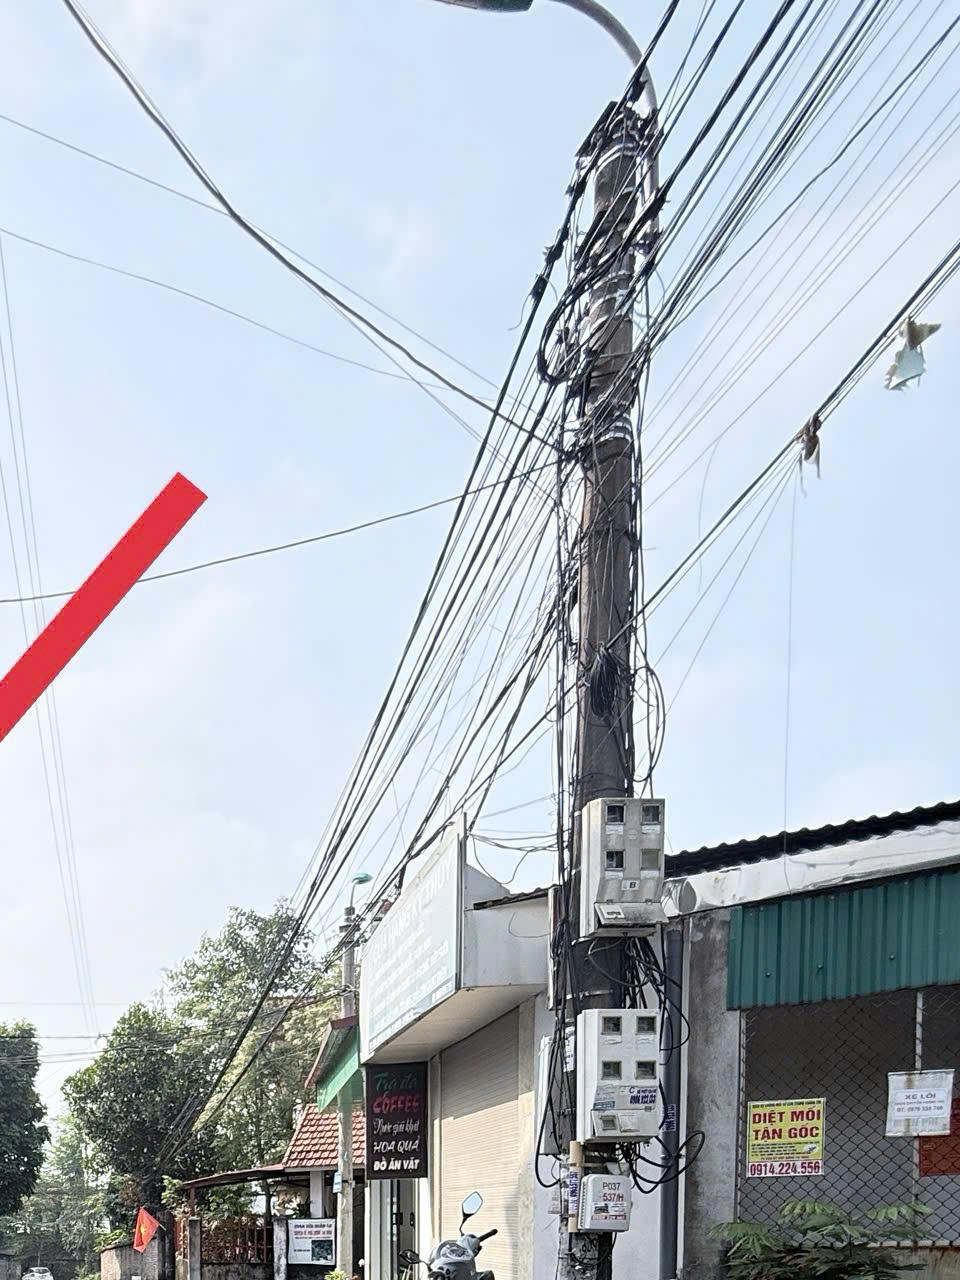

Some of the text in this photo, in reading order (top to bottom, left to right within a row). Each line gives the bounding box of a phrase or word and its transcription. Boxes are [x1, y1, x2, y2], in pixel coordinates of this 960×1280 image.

[752, 1106, 820, 1126] DIỆT MỐI
[753, 1123, 819, 1142] TẬN GỐC
[373, 1141, 395, 1153] HOA
[373, 1157, 387, 1171] ĐỒ
[388, 1158, 401, 1170] ĂN
[750, 1161, 820, 1176] 0914.224.556
[602, 1182, 621, 1191] P037
